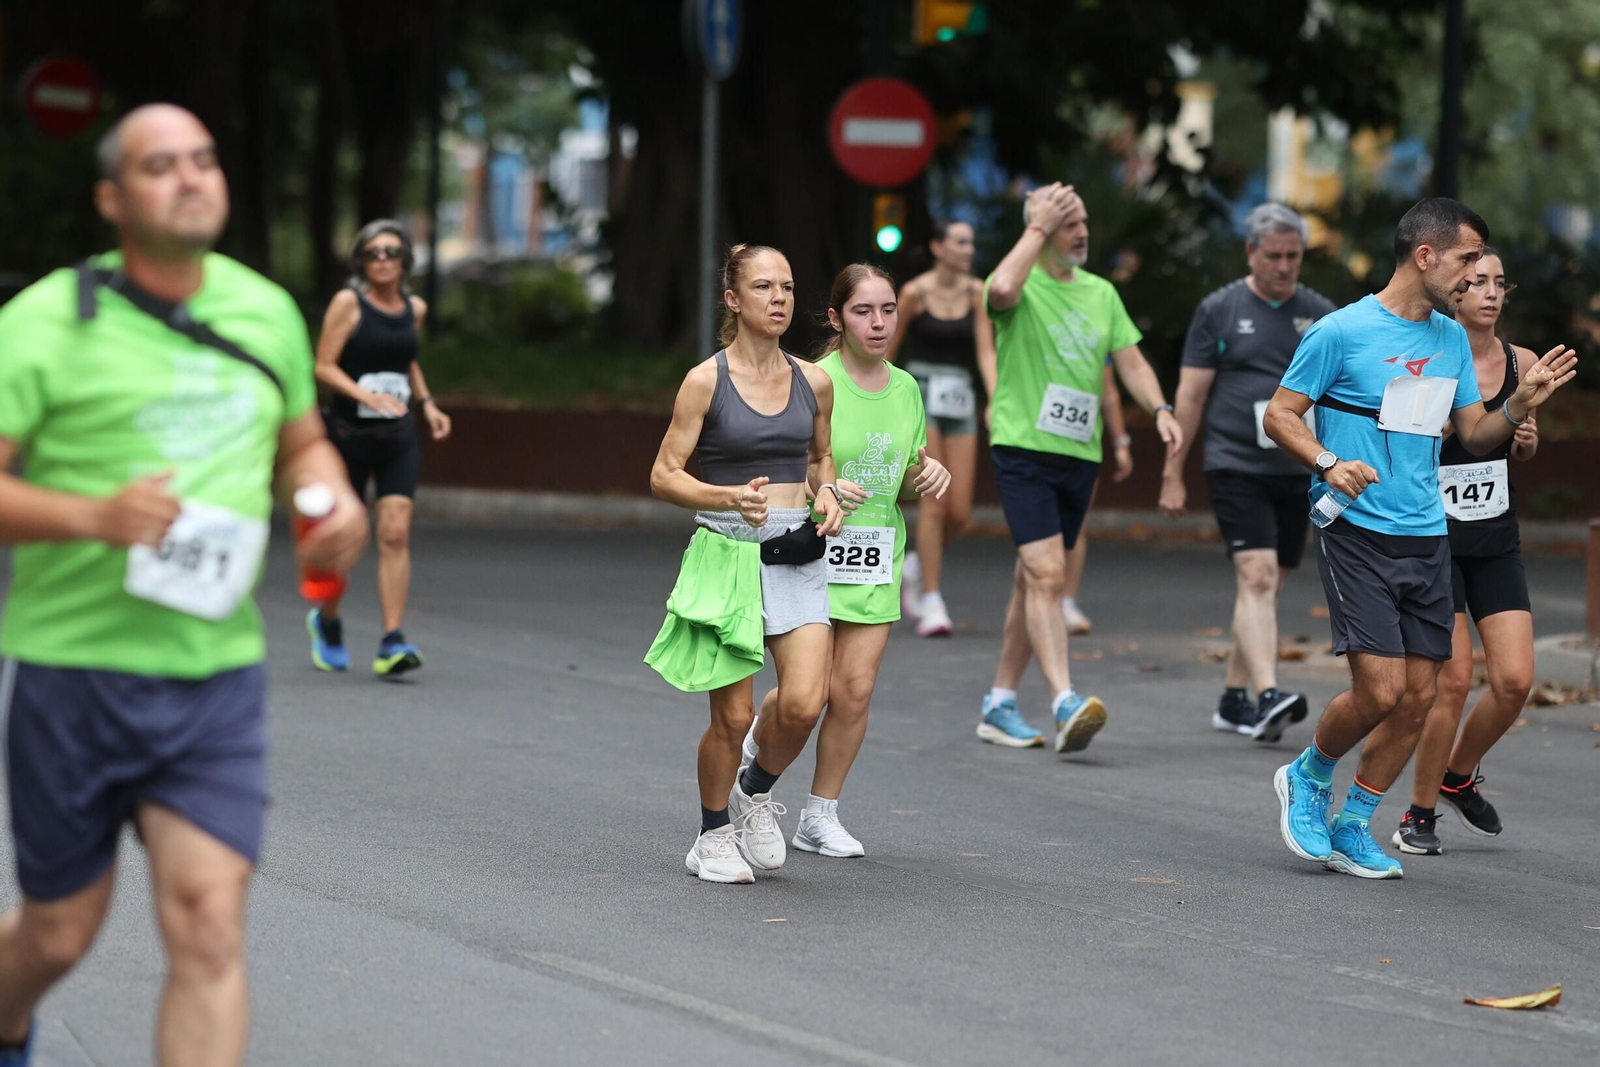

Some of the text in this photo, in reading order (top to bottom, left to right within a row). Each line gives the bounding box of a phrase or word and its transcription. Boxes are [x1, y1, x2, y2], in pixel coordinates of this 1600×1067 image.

[1050, 402, 1089, 427] 334
[842, 461, 891, 478] Carrera
[1444, 481, 1495, 504] 147
[828, 545, 881, 567] 328
